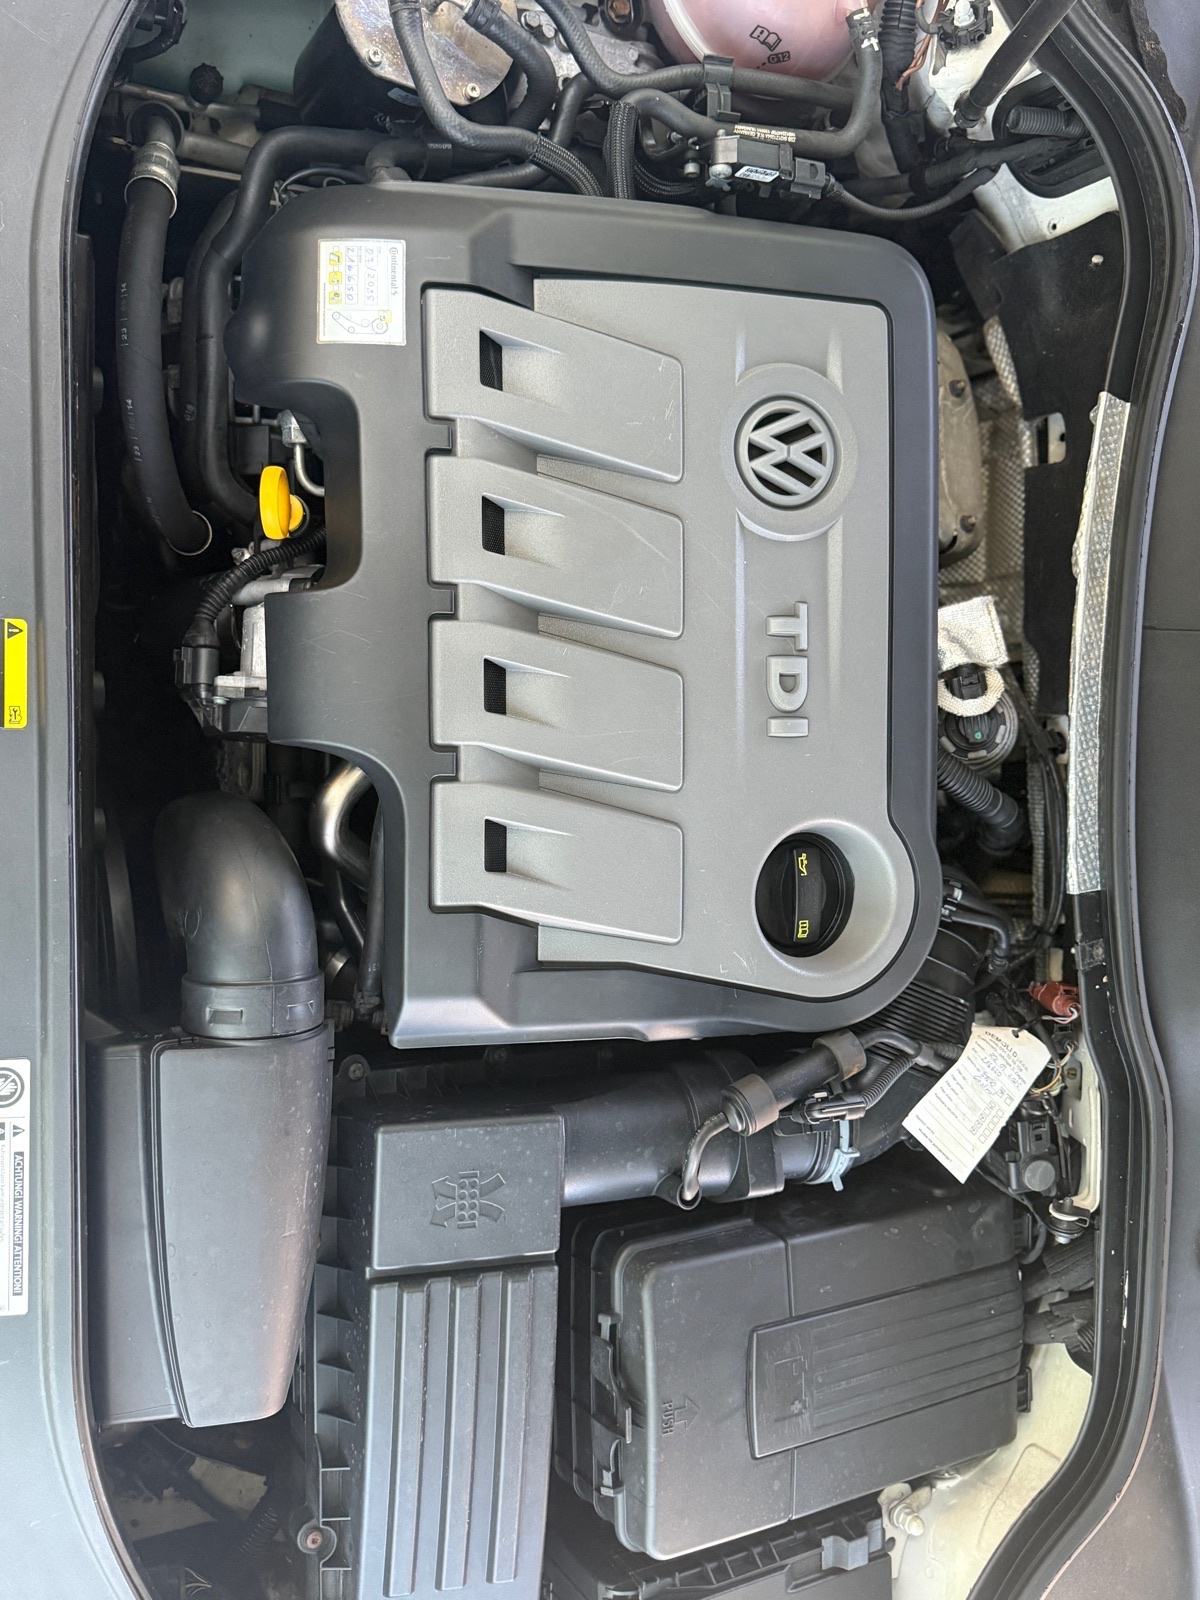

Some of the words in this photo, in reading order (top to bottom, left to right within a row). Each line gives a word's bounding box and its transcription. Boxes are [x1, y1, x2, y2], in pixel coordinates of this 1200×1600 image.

[769, 52, 789, 64] G12
[389, 247, 399, 289] Continental
[766, 601, 808, 737] TDI
[14, 1154, 23, 1199] ACHTUNG!
[14, 1200, 23, 1244] WARNING!
[13, 1245, 22, 1294] ATTENTION!
[662, 1401, 673, 1436] PUSH
